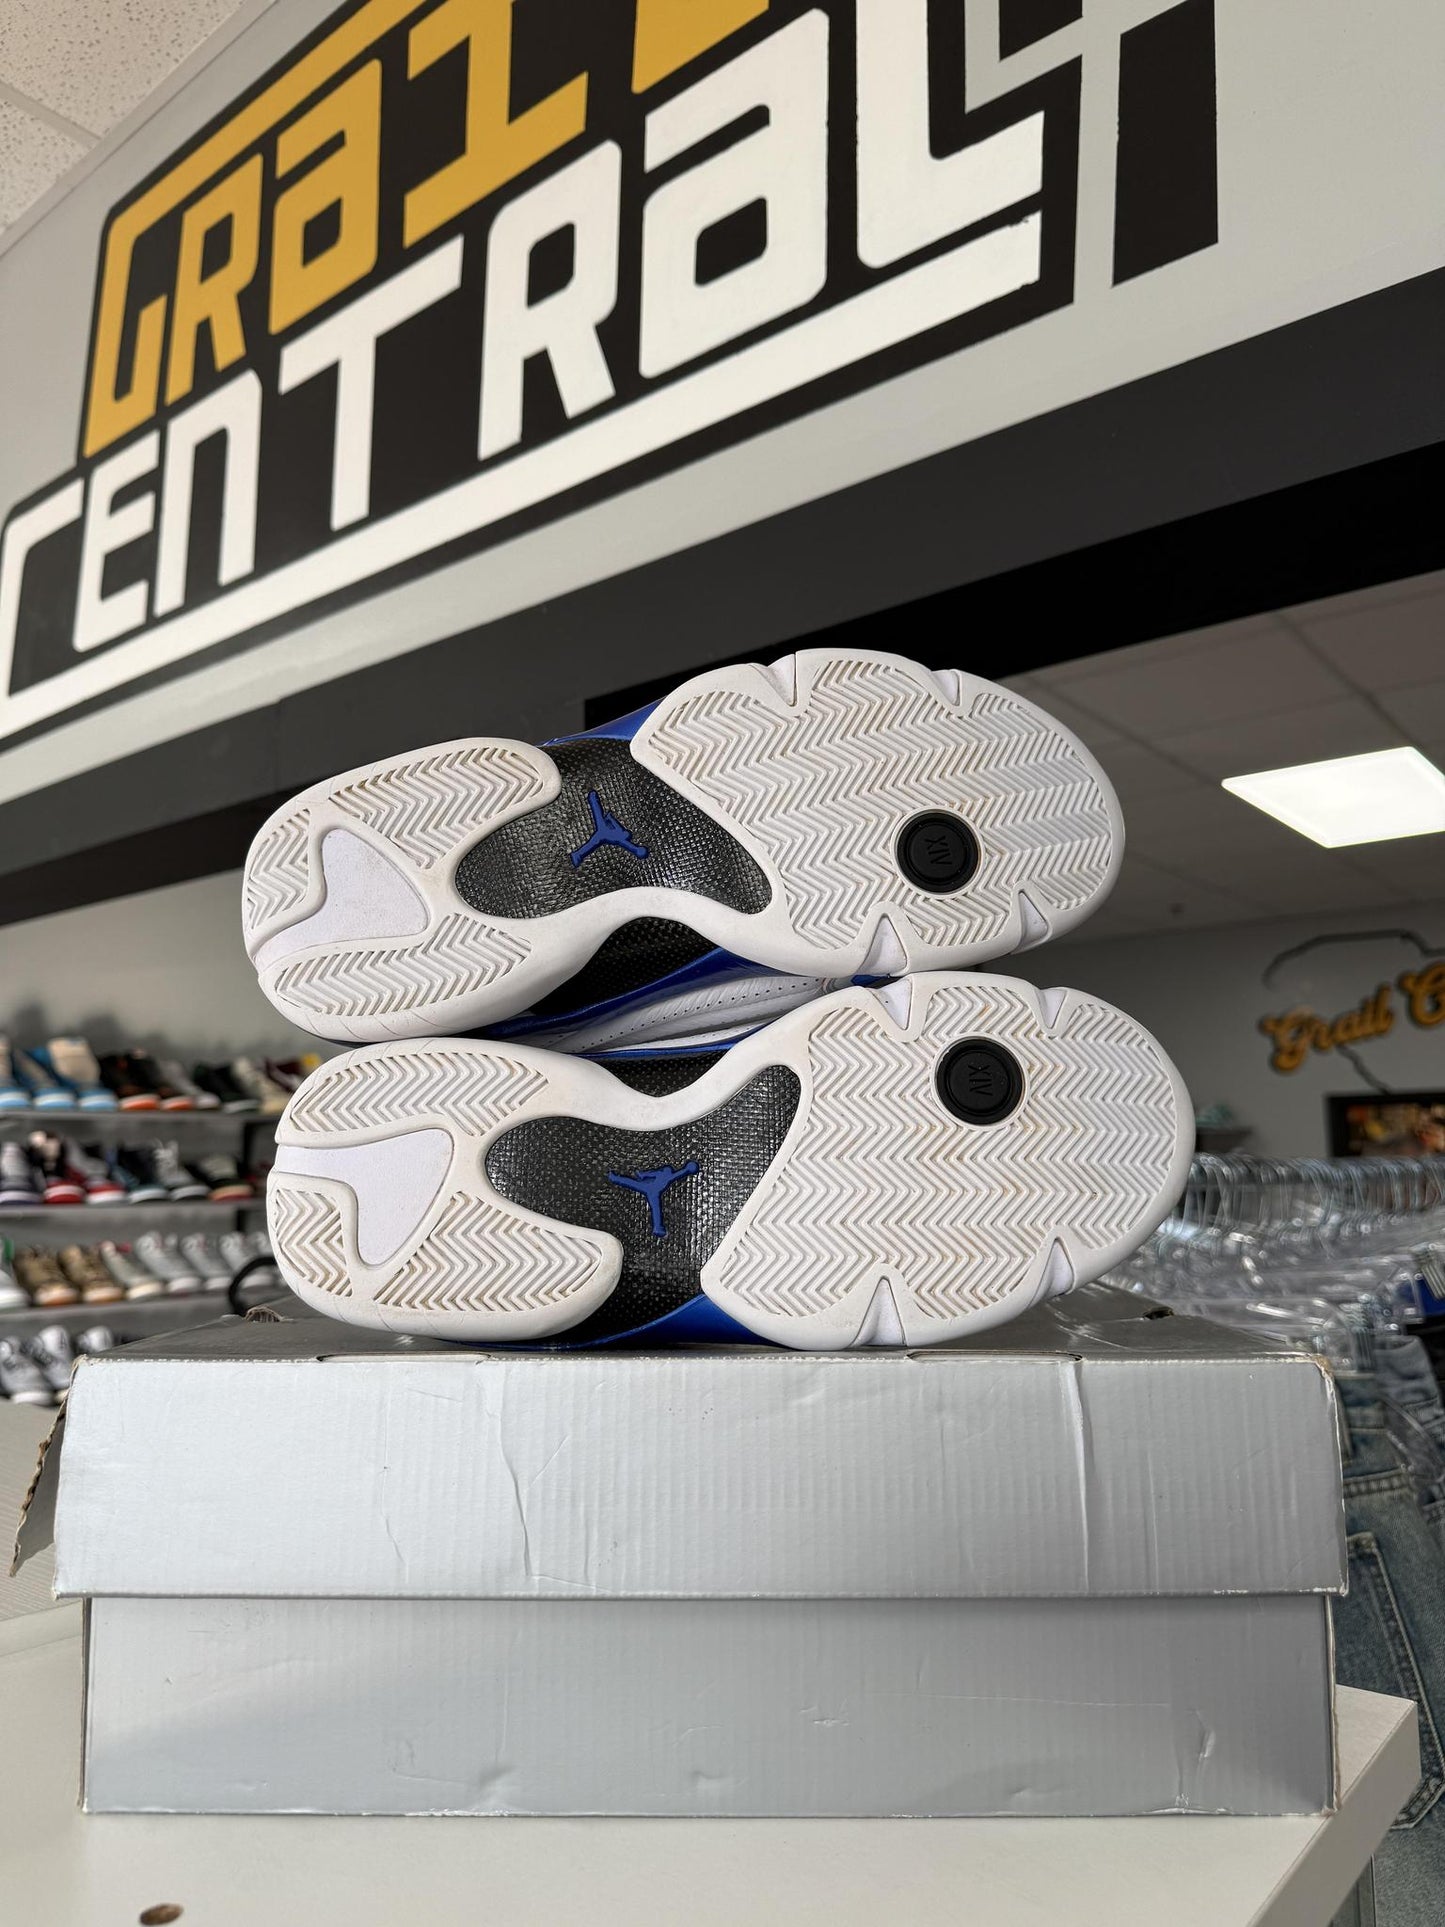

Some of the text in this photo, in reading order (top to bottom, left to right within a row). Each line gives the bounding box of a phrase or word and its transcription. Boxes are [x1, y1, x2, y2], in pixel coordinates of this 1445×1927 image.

[924, 835, 953, 865] XIV
[1259, 985, 1394, 1073] Grail
[968, 1064, 994, 1096] XIV
